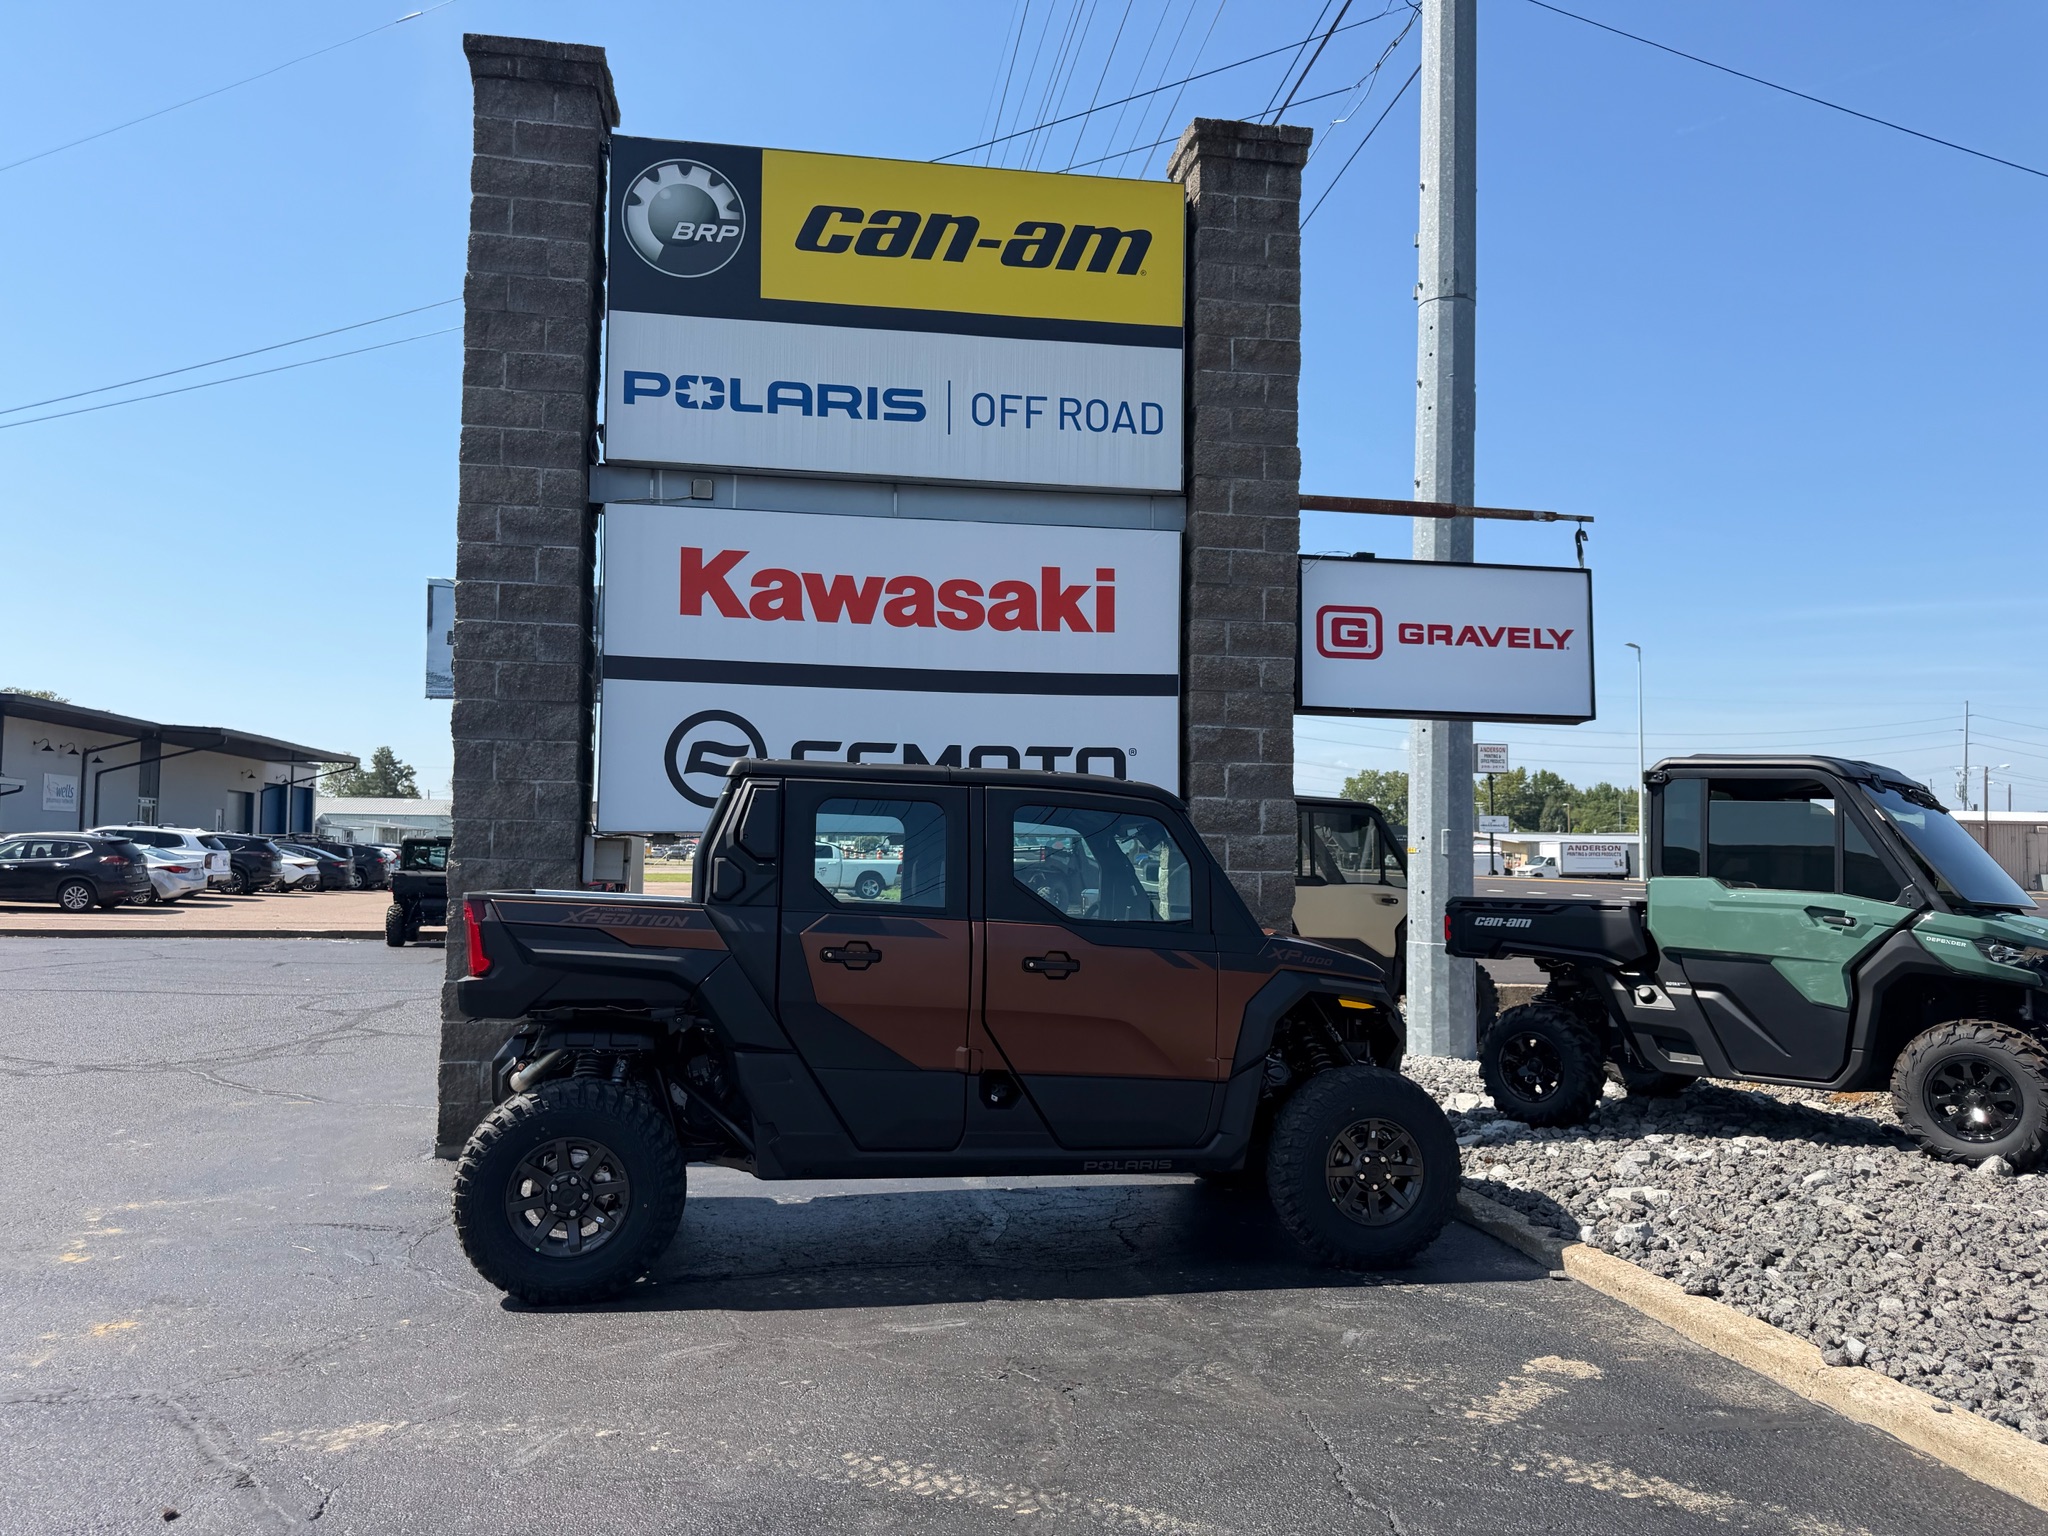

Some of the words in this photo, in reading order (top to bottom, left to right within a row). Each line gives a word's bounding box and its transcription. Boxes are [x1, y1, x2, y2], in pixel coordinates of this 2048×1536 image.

[672, 221, 740, 243] BRP
[795, 204, 1153, 276] can-am
[623, 369, 927, 423] POLARIS
[971, 392, 1049, 429] OFF
[1059, 398, 1165, 436] ROAD
[679, 546, 1116, 634] Kawasaki
[1398, 622, 1575, 651] GRAVELY
[56, 784, 74, 798] wells
[1567, 844, 1622, 852] ANDERSON
[559, 907, 689, 927] XPEDITION
[1474, 916, 1532, 928] can-am
[1926, 936, 1967, 947] DEFENDER
[1267, 947, 1303, 960] XP
[1302, 955, 1333, 966] 1000
[1083, 1160, 1172, 1171] POLARIS
